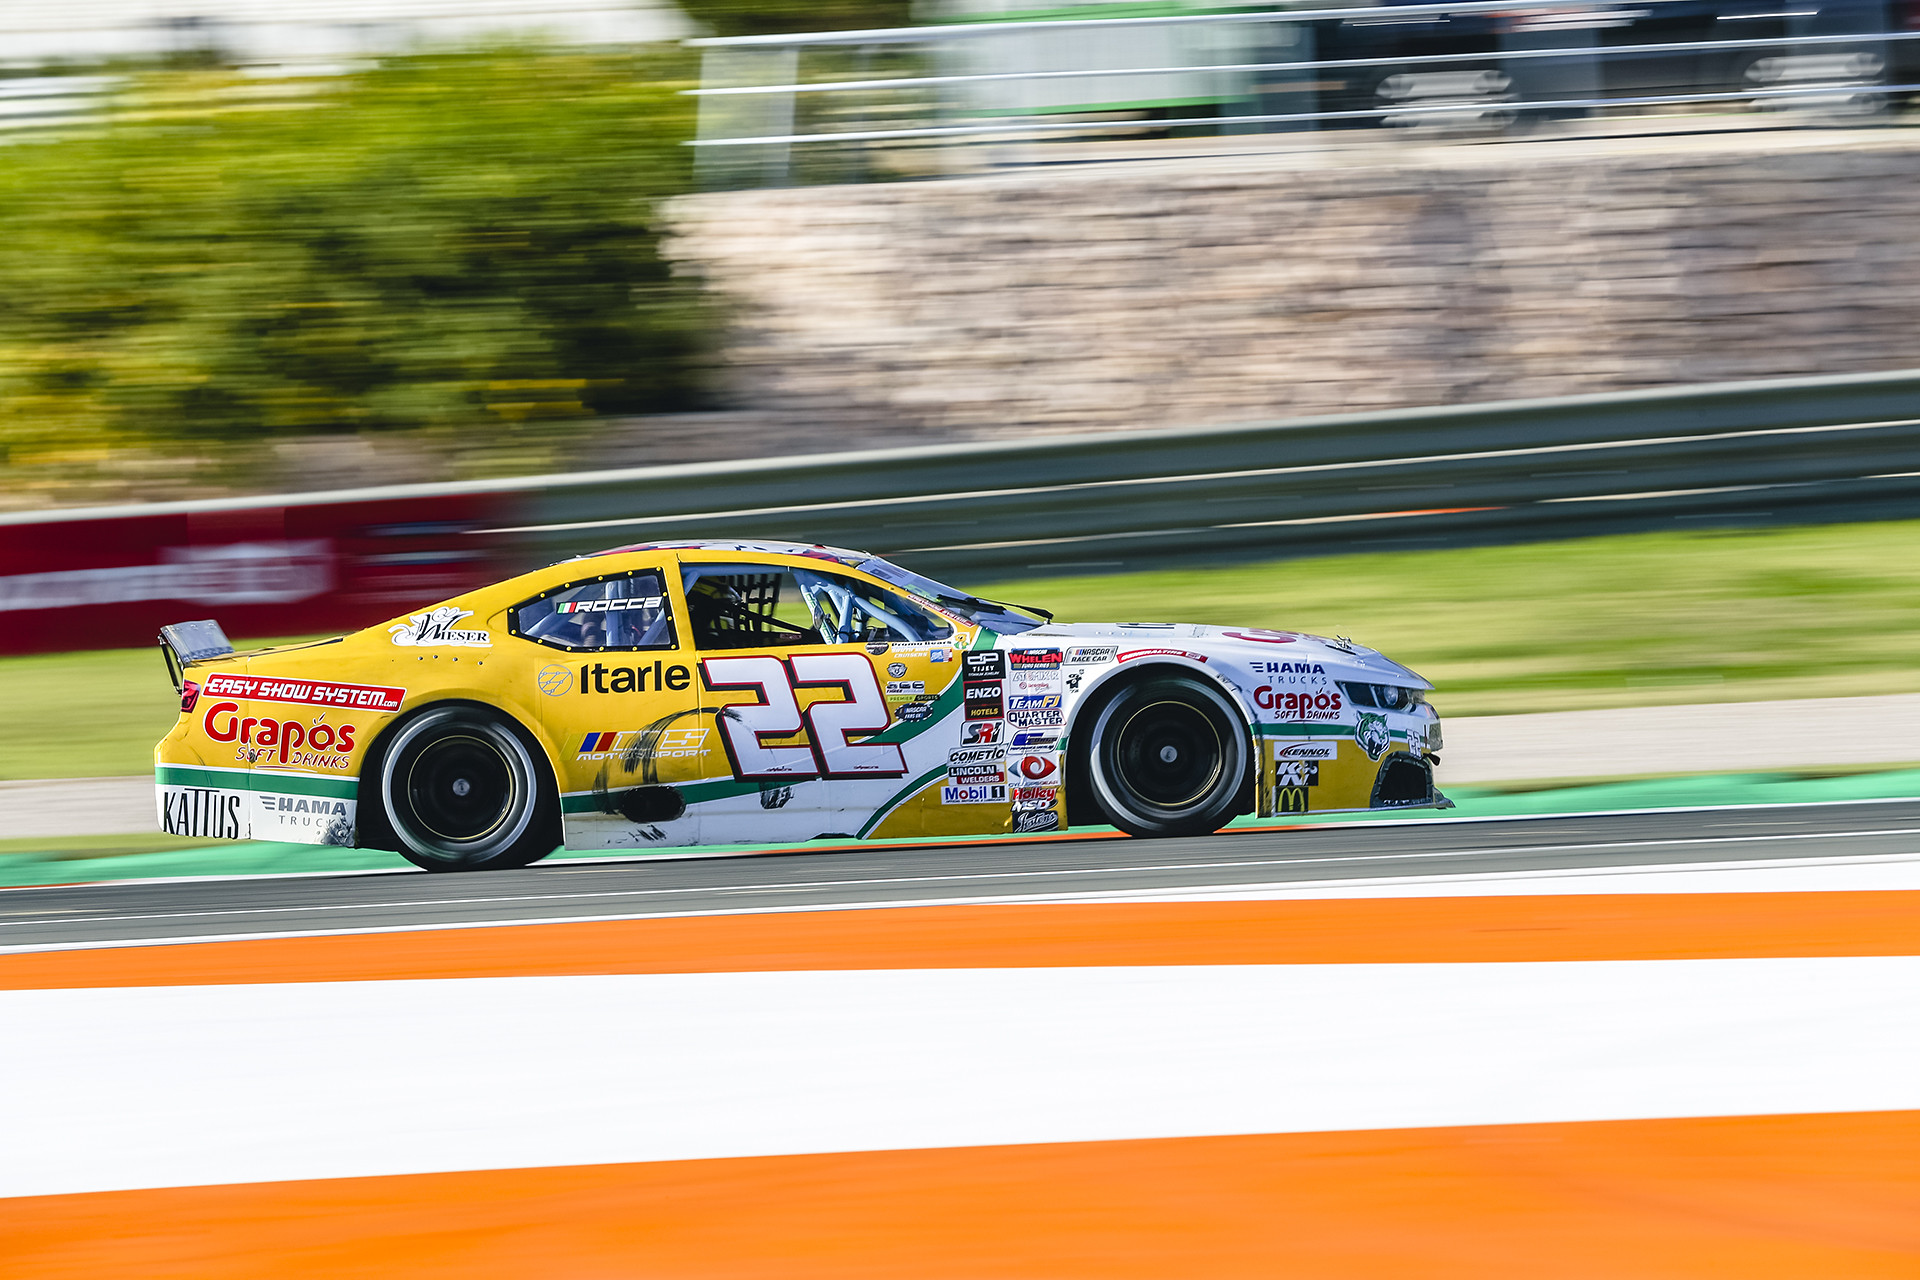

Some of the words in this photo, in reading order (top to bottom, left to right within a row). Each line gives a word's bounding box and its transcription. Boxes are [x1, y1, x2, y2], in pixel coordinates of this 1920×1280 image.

[416, 612, 487, 641] WIESER
[1008, 652, 1063, 664] WHELEN
[1266, 662, 1325, 675] HAMA
[581, 660, 691, 694] Itarle
[1268, 676, 1327, 685] TRUCKS
[207, 678, 256, 695] EASY
[259, 682, 313, 700] SHOW
[965, 687, 1002, 700] ENZO
[698, 652, 909, 782] 22
[970, 707, 999, 716] HOTELS
[1009, 710, 1060, 722] QUARTER
[1274, 710, 1297, 720] SOFT
[1307, 711, 1340, 720] DRINKS
[1018, 718, 1062, 727] MASTER
[235, 747, 278, 763] SOFT
[290, 751, 350, 769] DRINKS
[1284, 748, 1331, 756] KENNOL
[950, 765, 995, 776] LINCOLN
[961, 776, 1000, 784] WELDERS
[945, 786, 987, 800] Mobil
[1013, 787, 1056, 801] Holley
[278, 797, 347, 816] HAMA
[1011, 800, 1052, 812] MSD
[163, 788, 240, 839] KATTUS
